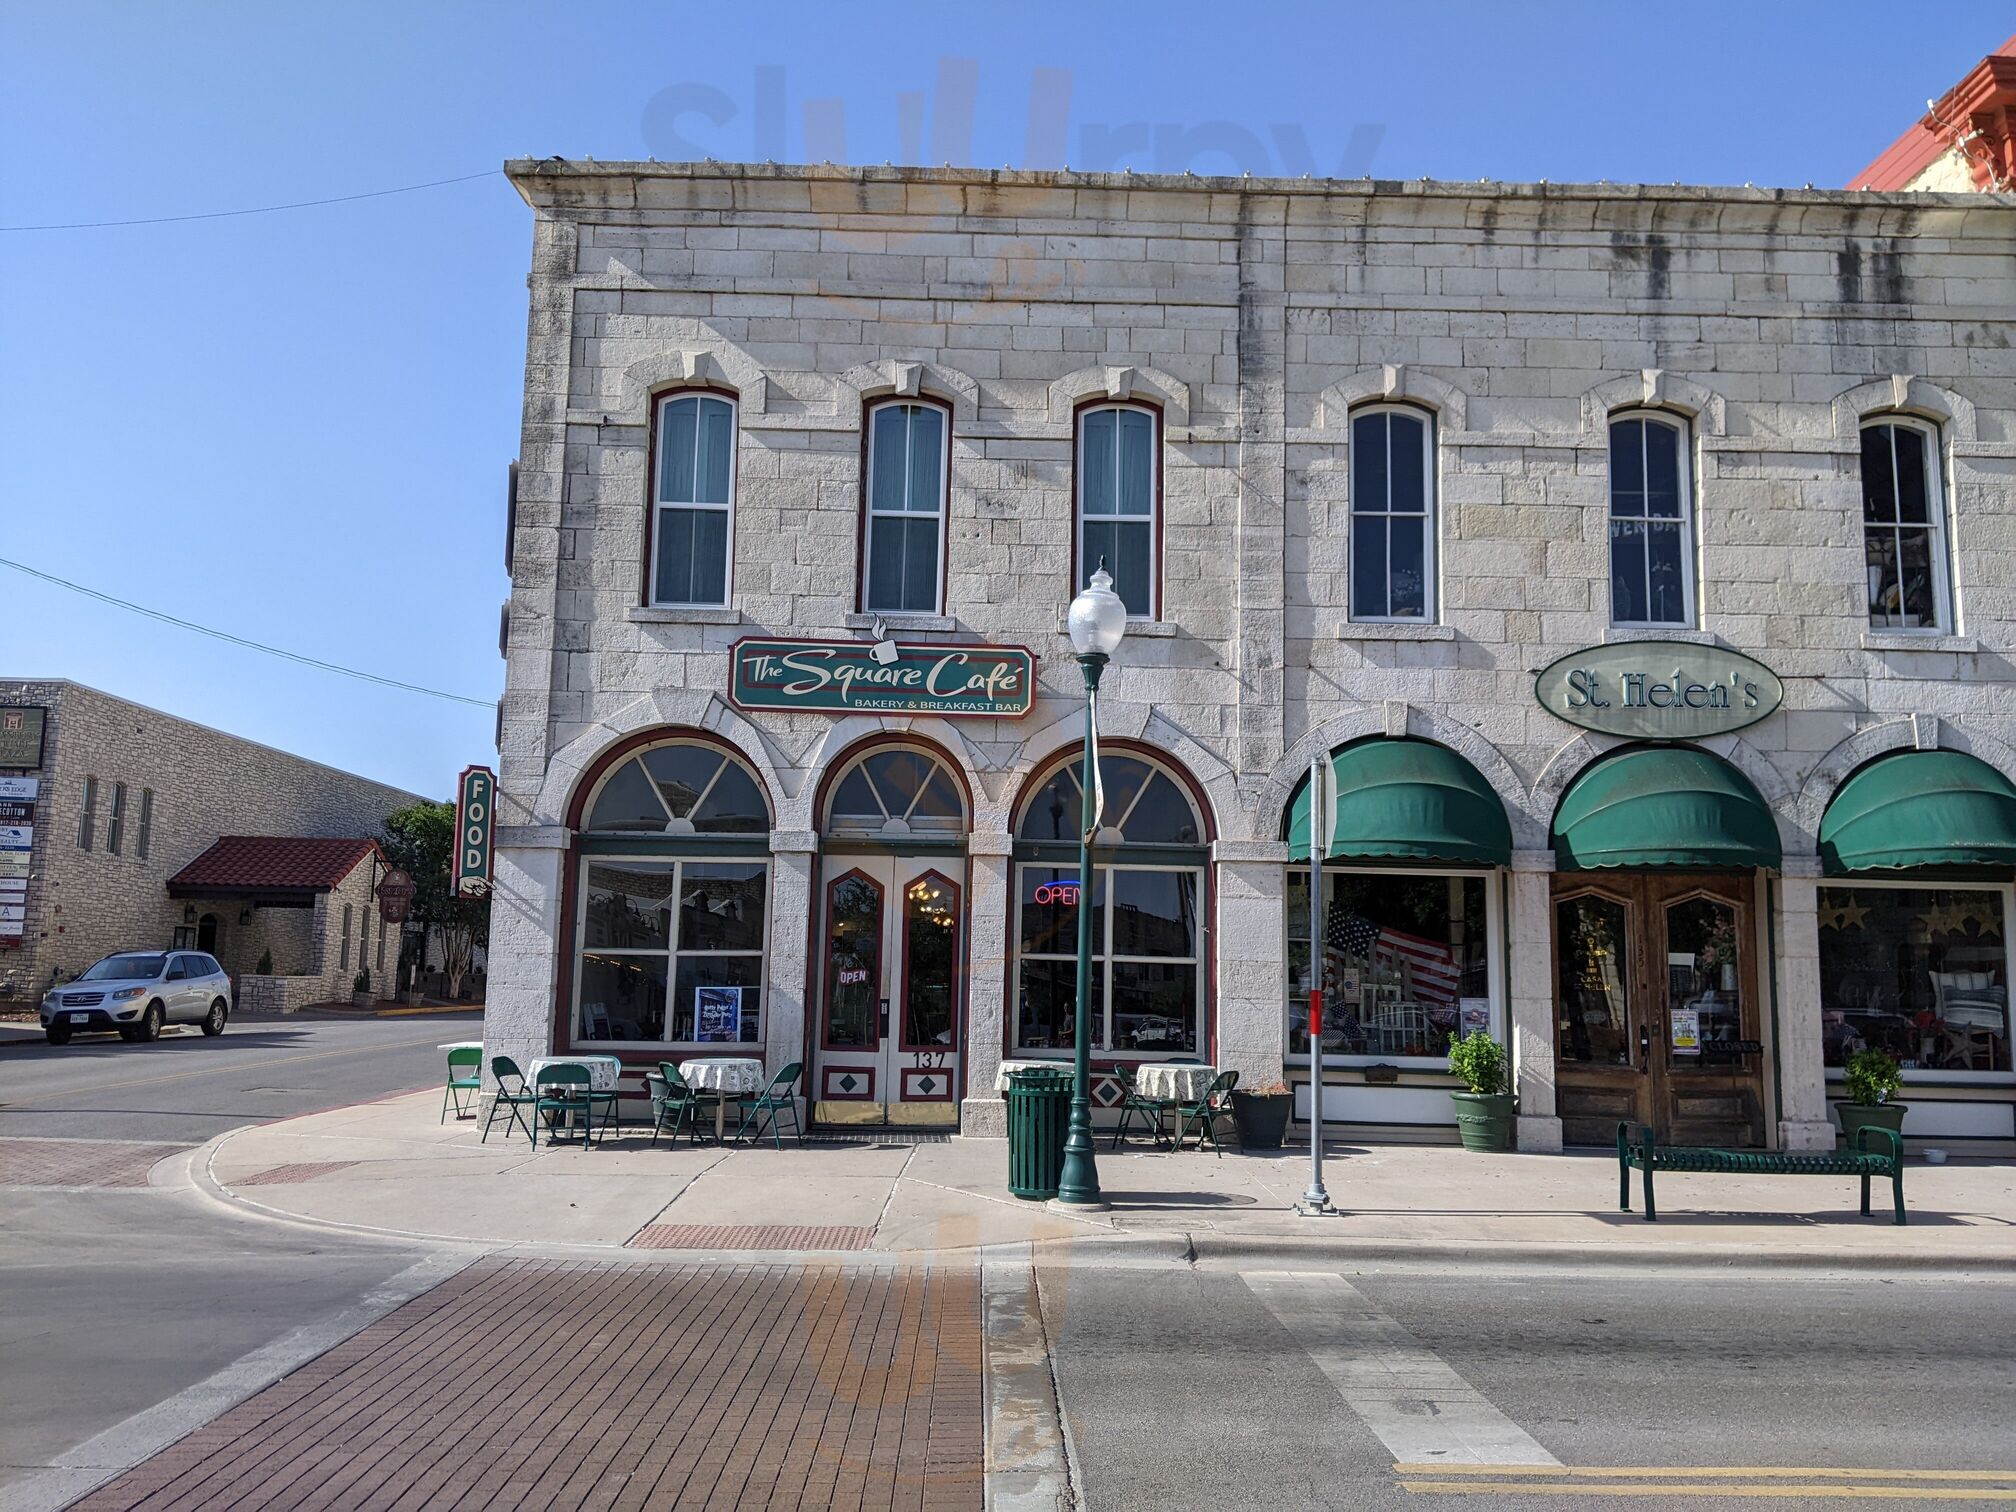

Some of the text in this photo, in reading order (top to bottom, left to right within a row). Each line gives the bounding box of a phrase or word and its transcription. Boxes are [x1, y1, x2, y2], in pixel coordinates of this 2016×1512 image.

[742, 649, 1024, 703] The Square Café
[1564, 667, 1758, 708] St. Helen's
[855, 699, 1021, 712] BAKERY & BREAKFAST BAR
[466, 780, 485, 869] FOOD
[840, 970, 866, 984] OPEN
[1709, 1041, 1760, 1052] CLOSED
[913, 1052, 946, 1069] 137
